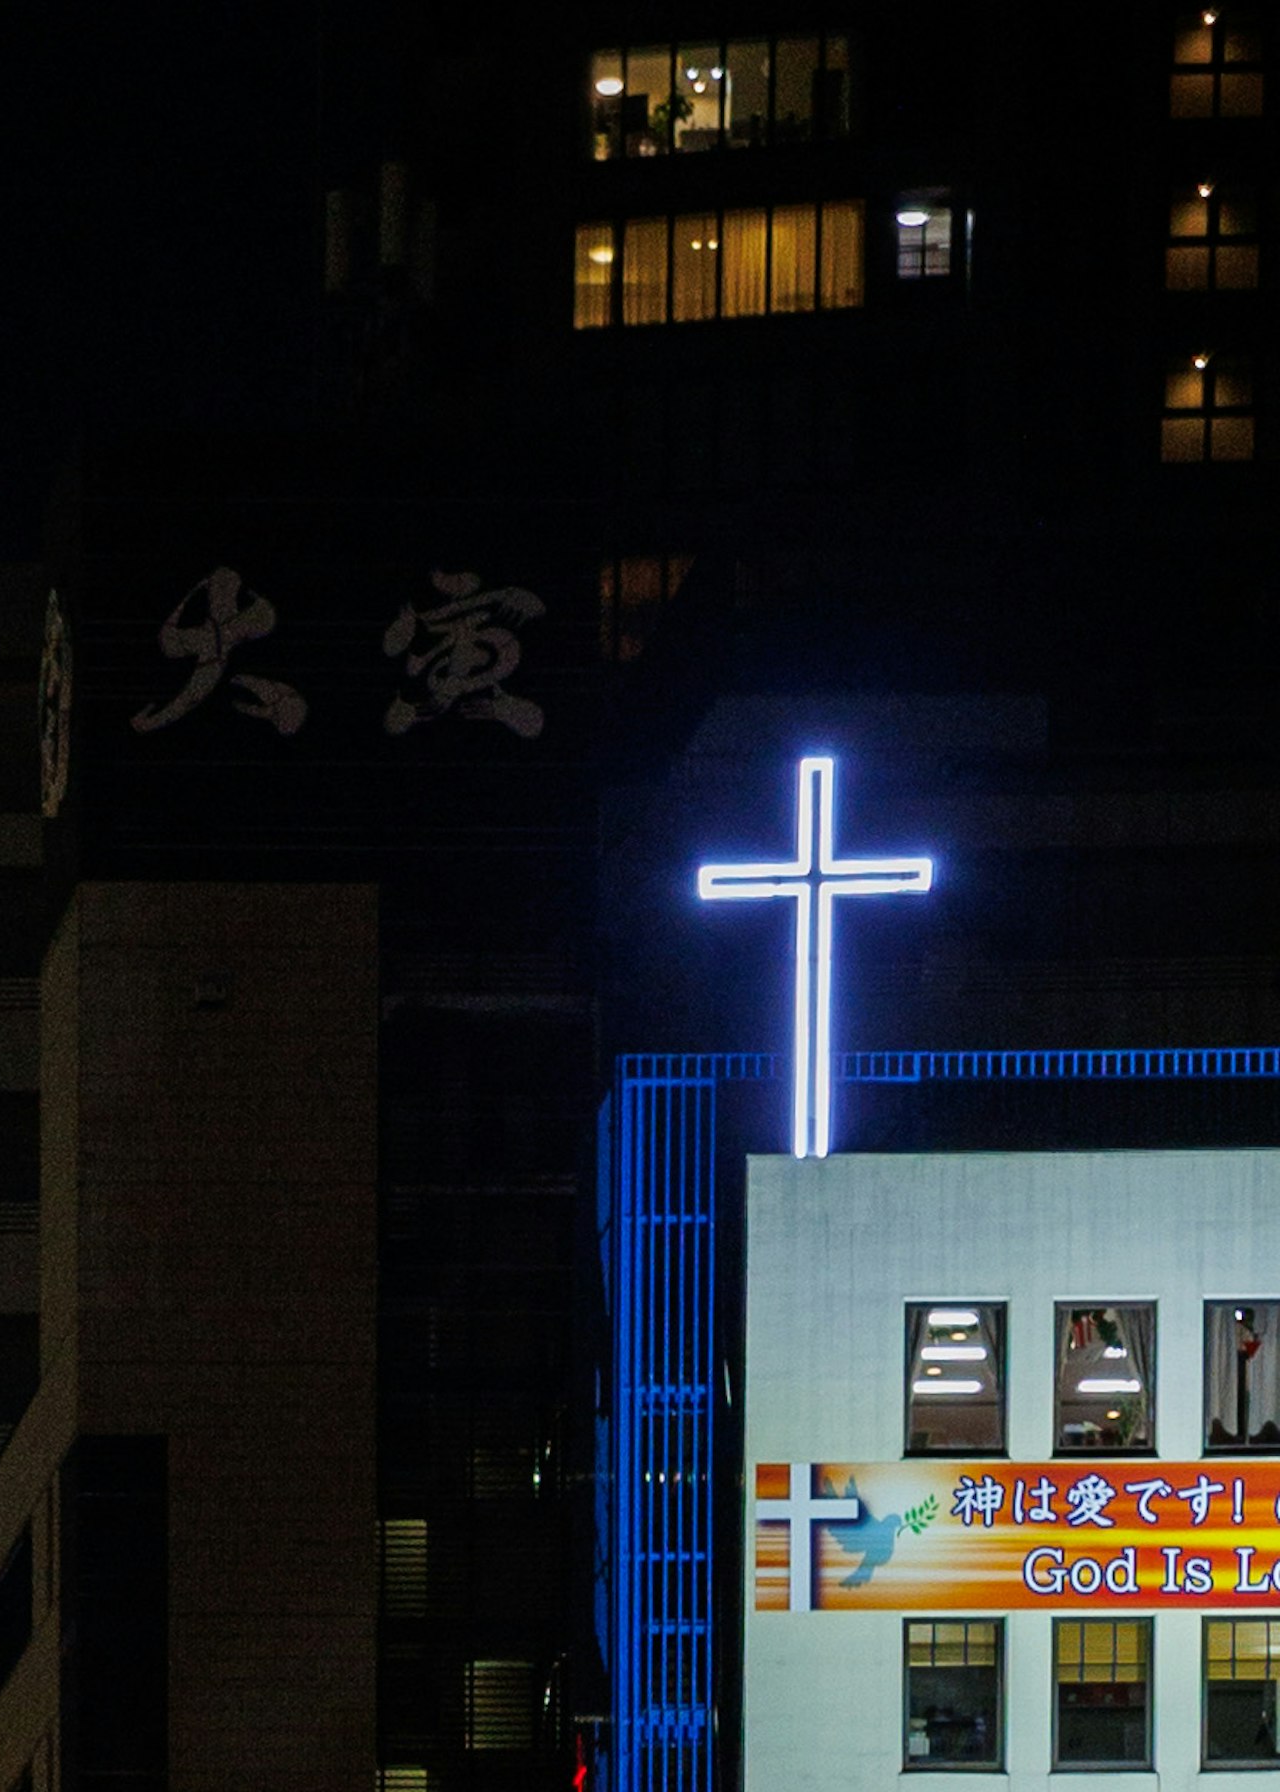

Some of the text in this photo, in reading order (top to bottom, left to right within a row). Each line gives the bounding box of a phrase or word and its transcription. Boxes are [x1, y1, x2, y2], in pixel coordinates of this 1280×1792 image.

[1023, 1546, 1280, 1595] God Is L
